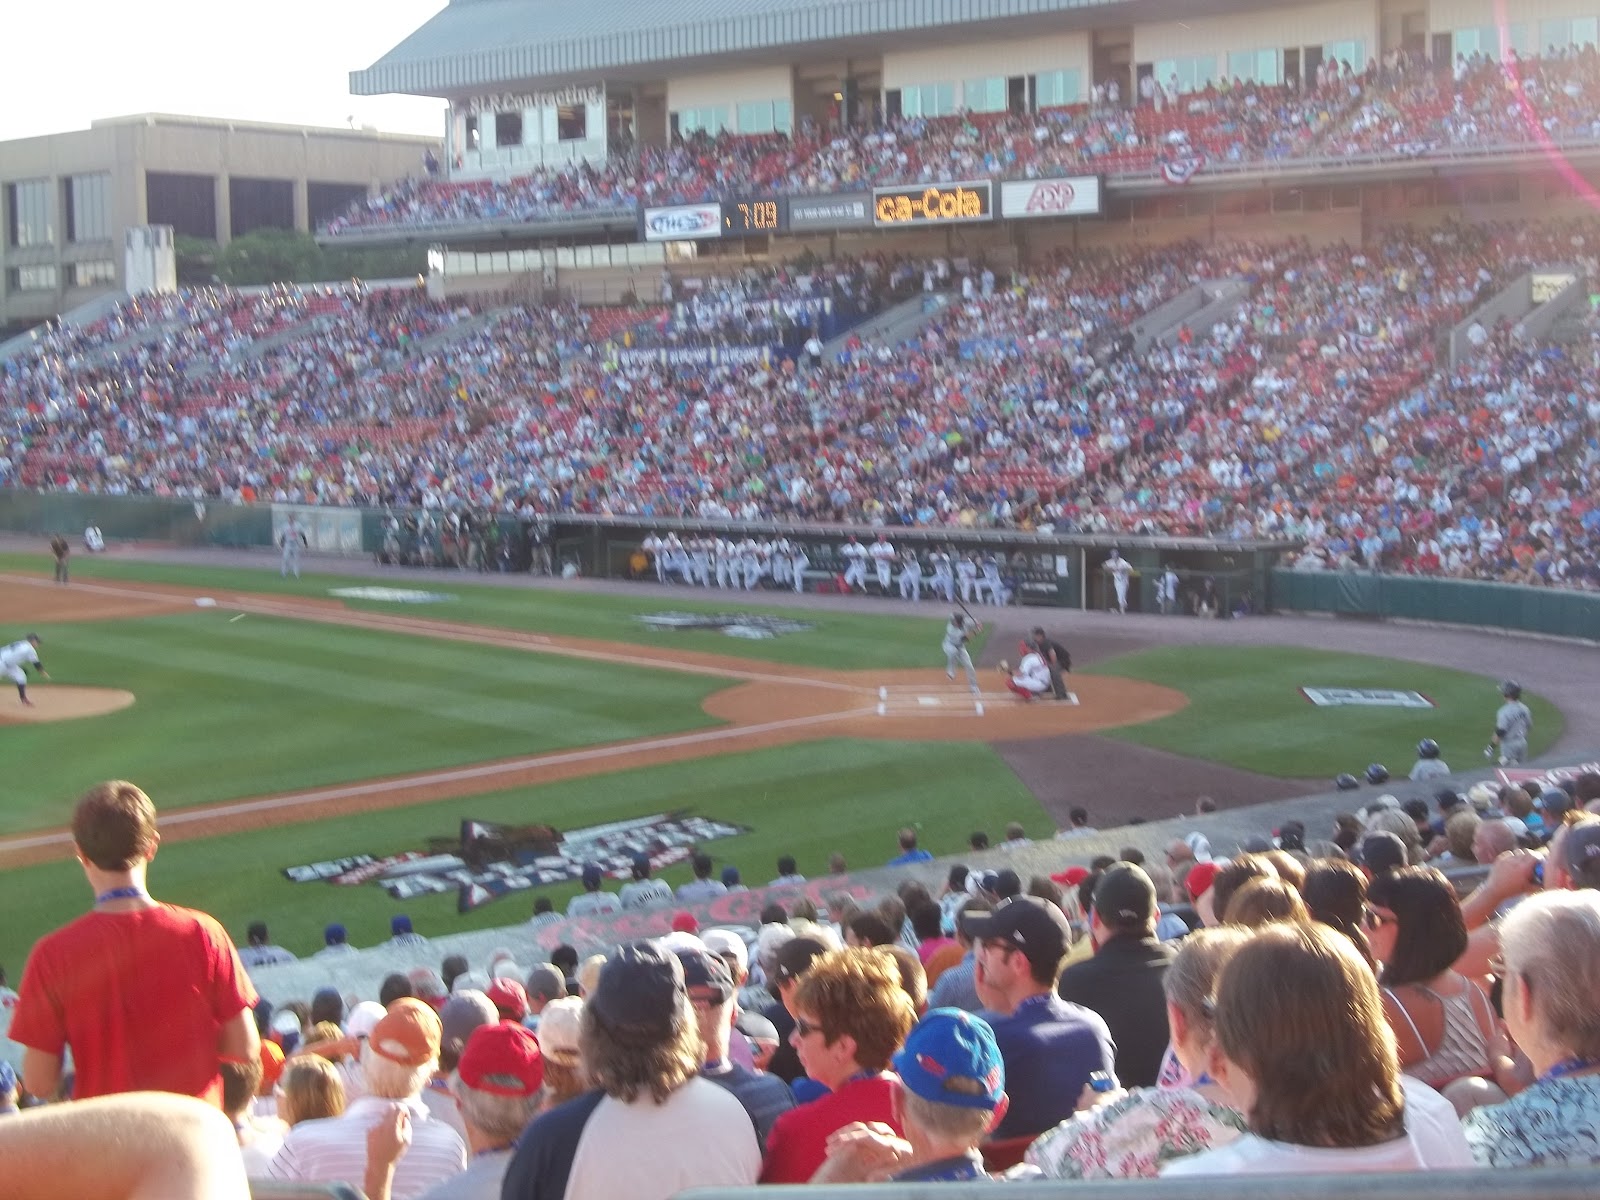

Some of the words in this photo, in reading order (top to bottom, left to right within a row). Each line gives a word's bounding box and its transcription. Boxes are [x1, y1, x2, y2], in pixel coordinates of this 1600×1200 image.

[502, 84, 602, 111] Contracting
[876, 185, 981, 222] ca-Cola
[1025, 181, 1075, 214] ADP
